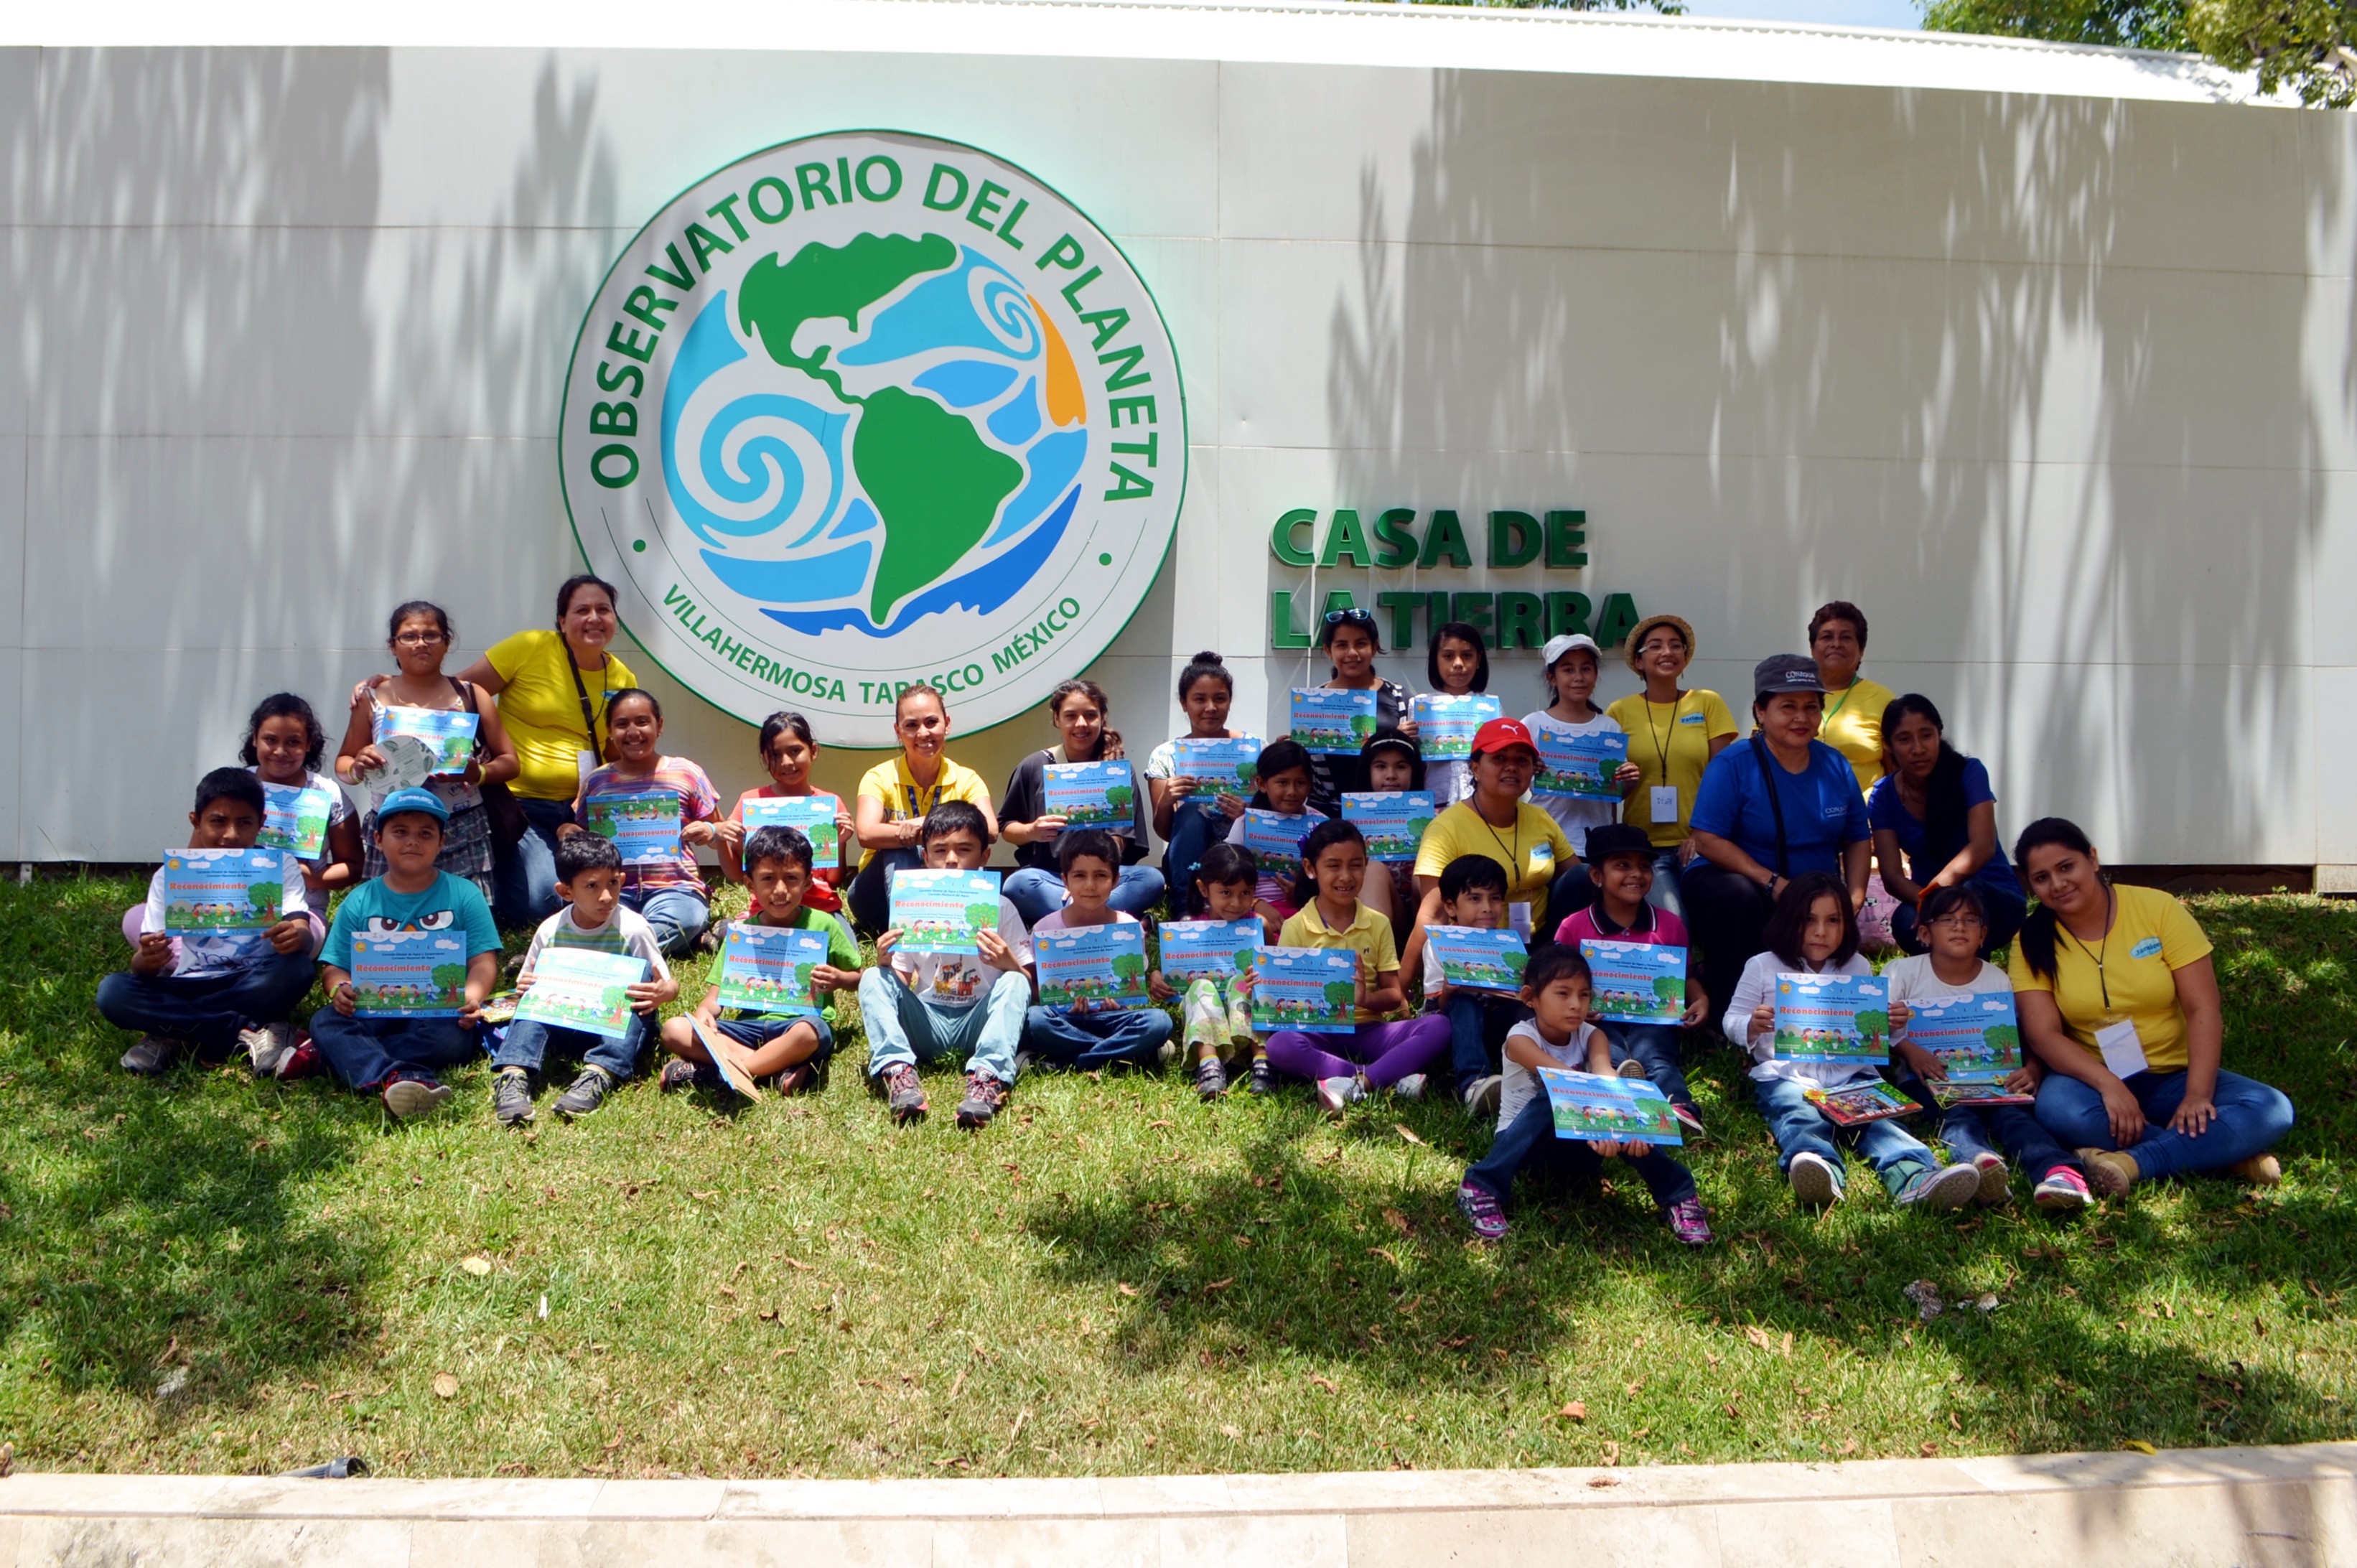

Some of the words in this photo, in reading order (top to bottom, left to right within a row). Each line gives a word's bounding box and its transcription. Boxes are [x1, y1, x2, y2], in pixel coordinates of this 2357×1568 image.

[589, 154, 902, 489] OBSERVATORIO
[923, 163, 1029, 250] DEL
[1035, 233, 1158, 501] PLANETA
[1270, 508, 1472, 569] CASA
[1488, 510, 1587, 569] DE
[1377, 590, 1640, 650] TIERRA
[663, 584, 845, 701] VILLAHERMOSA
[859, 663, 984, 704] TABSCO
[991, 597, 1081, 673] MÉXICO
[1249, 834, 1298, 844] Reconocimien
[729, 955, 795, 968] Reconocimiento
[1165, 951, 1233, 959] Reconocimiento
[1041, 956, 1110, 969] Reconocimiento
[538, 975, 604, 989] econocimiento
[1591, 971, 1653, 981] conocimiento
[1780, 1006, 1854, 1017] Reconocimiento
[1908, 1027, 1982, 1038] Reconocimiento
